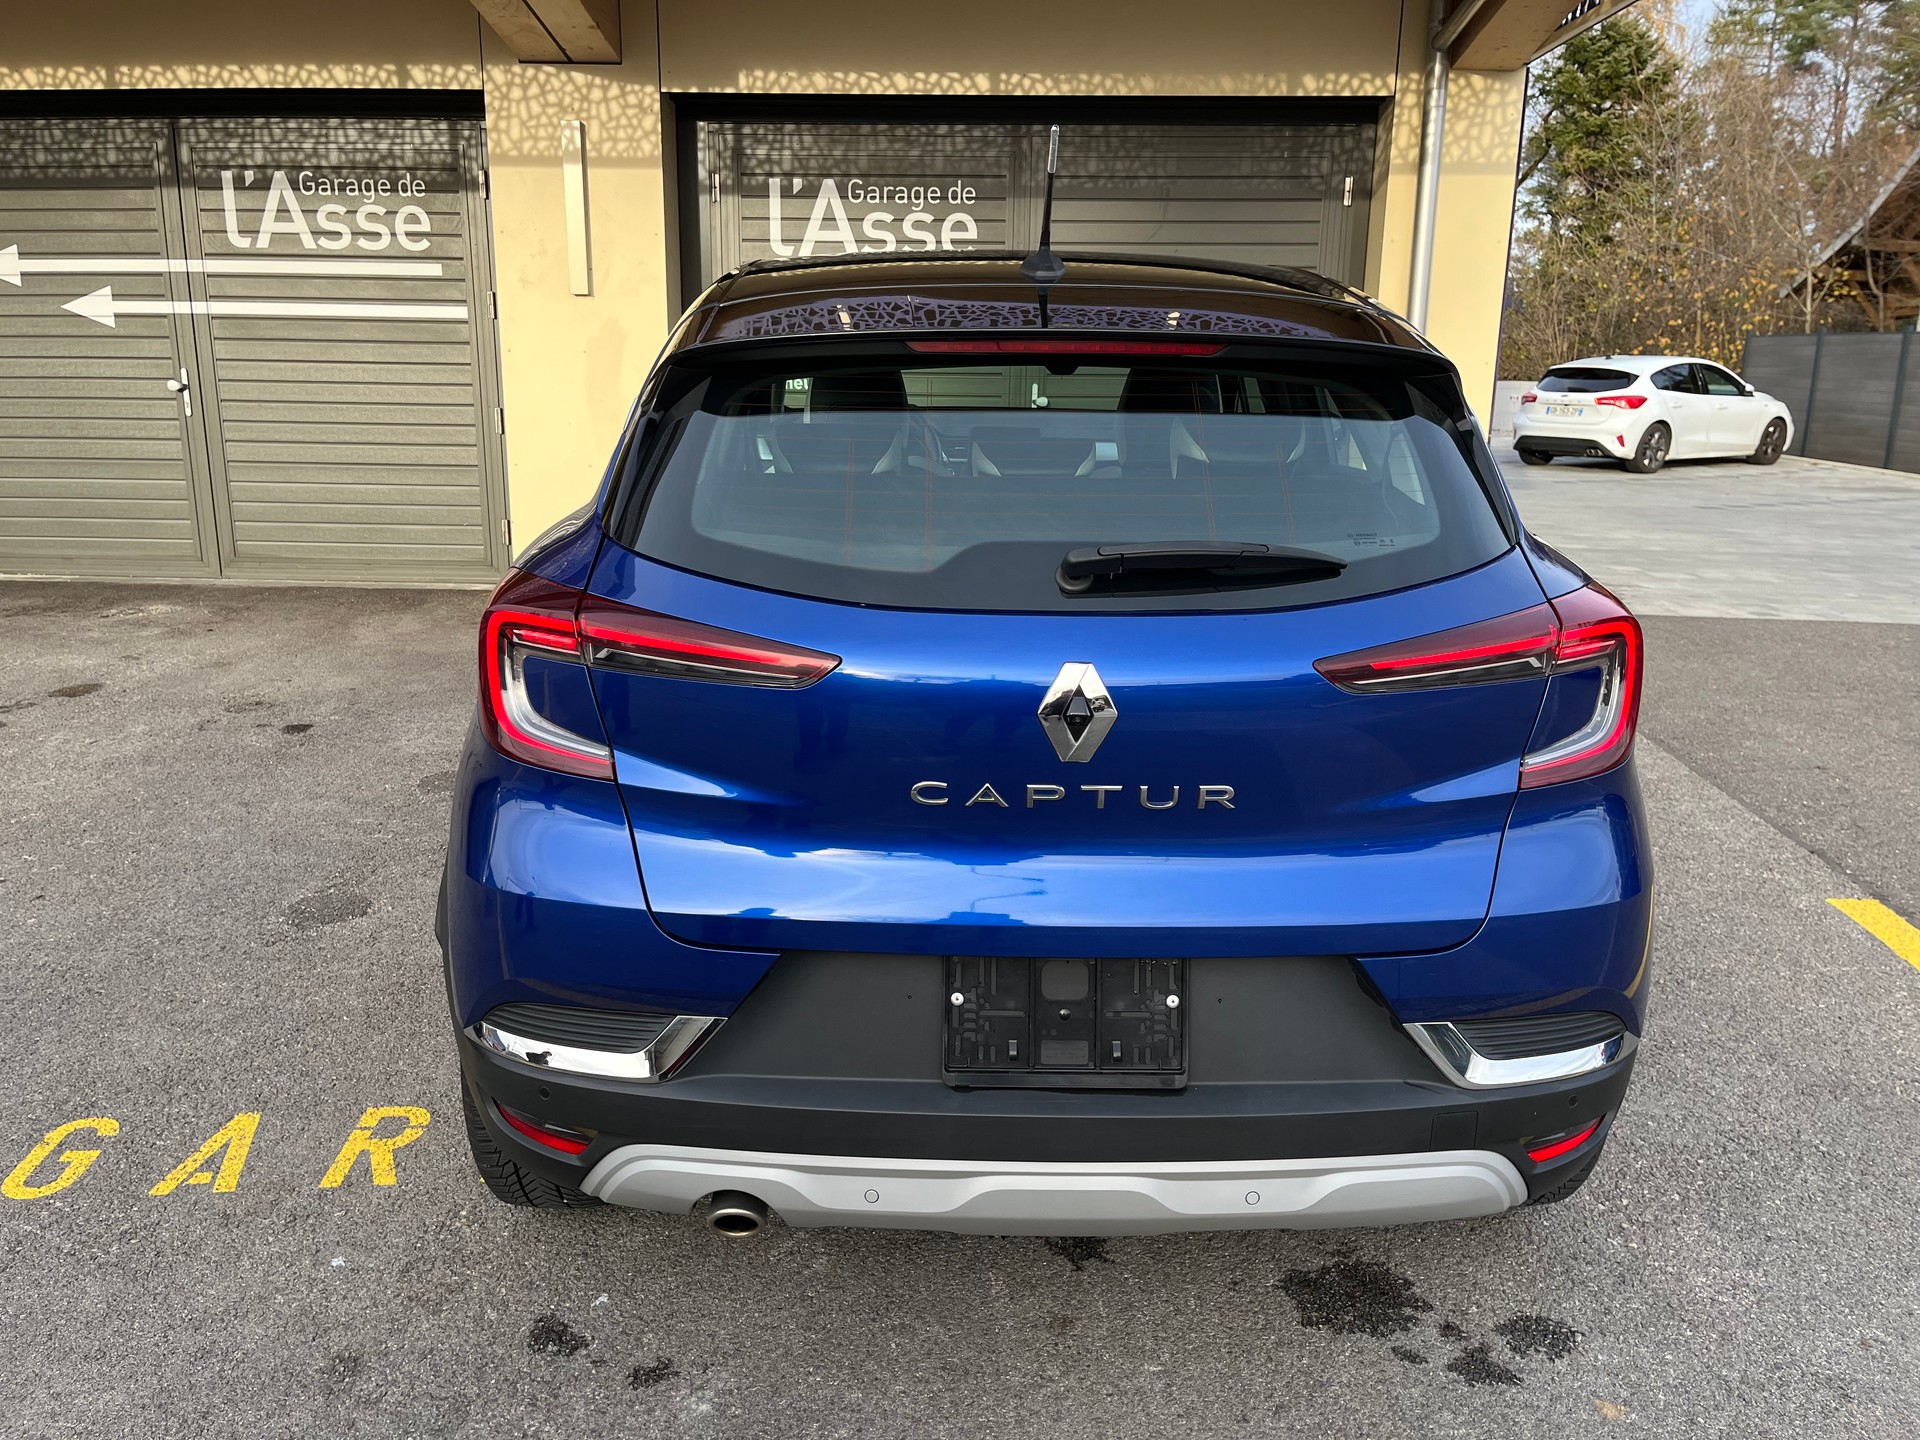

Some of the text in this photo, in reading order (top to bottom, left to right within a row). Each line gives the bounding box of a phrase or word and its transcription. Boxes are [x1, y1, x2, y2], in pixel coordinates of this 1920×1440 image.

[299, 171, 426, 203] Garage de
[848, 179, 976, 211] Garage de
[221, 170, 432, 251] l'Asse
[768, 178, 978, 257] l'Asse
[910, 781, 1236, 809] CAPTUR
